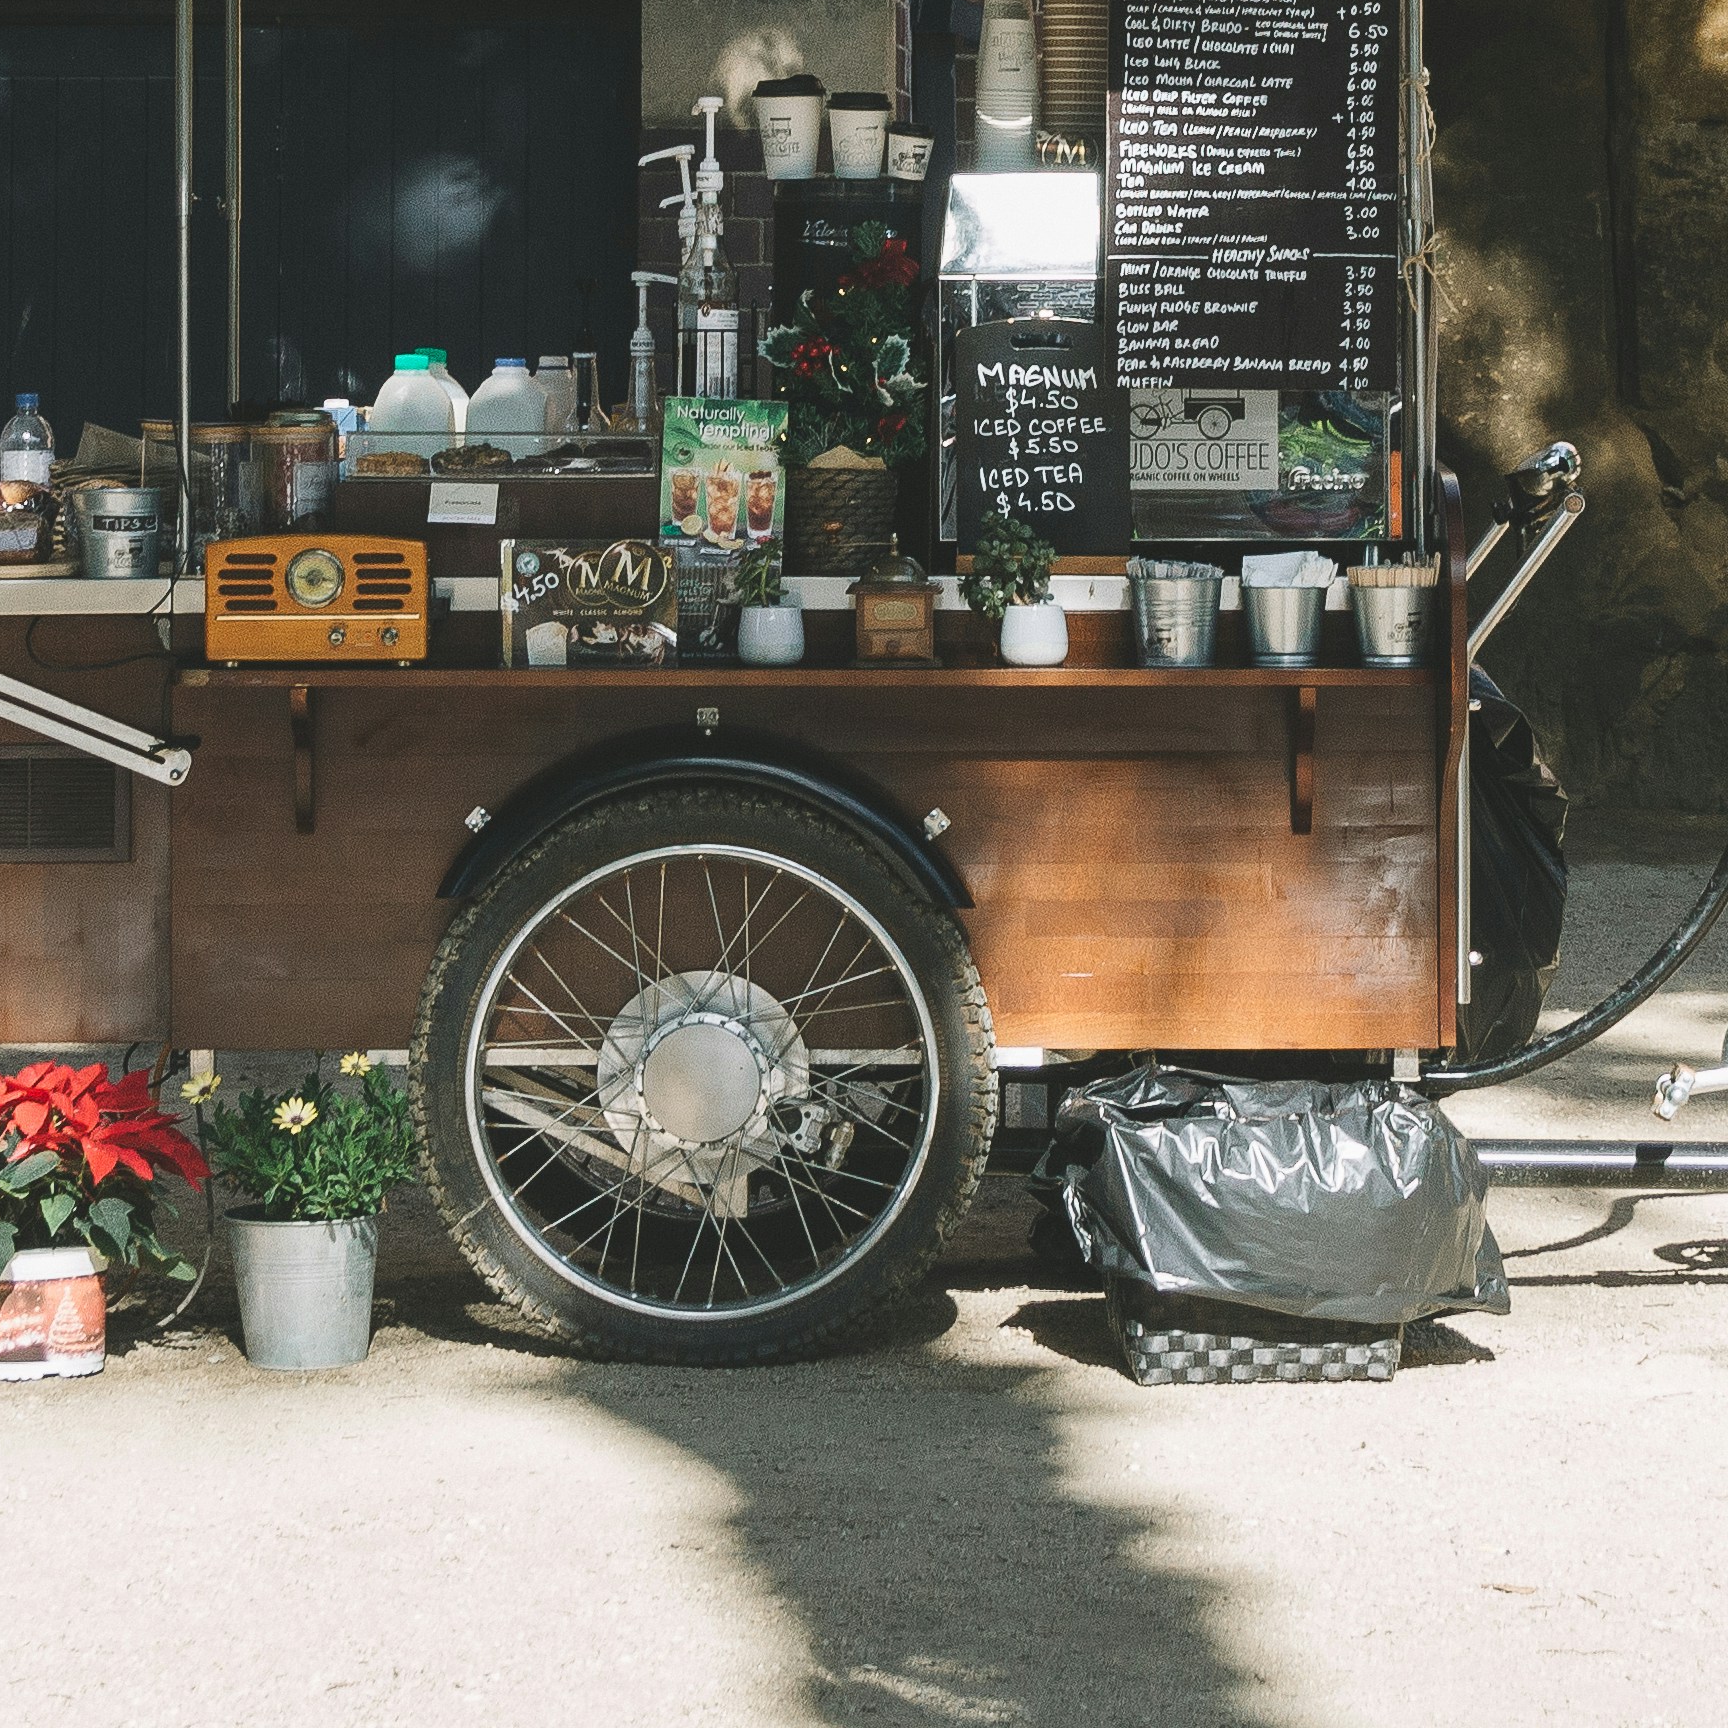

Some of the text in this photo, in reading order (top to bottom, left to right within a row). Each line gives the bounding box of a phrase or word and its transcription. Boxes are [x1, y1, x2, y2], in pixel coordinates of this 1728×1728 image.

[1350, 2, 1381, 16] 0.50
[1124, 15, 1150, 30] COOL
[1163, 17, 1196, 34] DIRTY
[1348, 22, 1388, 40] 6.50
[1126, 32, 1379, 58] ICED LATTE CHOCOLATE CHAI 5.50
[1124, 53, 1149, 68] ICED
[1184, 56, 1221, 71] BLACK
[1349, 60, 1378, 76] 5.00
[1124, 70, 1377, 92] ICED MOCHA CHARCOAL LATTE 6.00
[1222, 92, 1269, 106] COFFEE
[1346, 94, 1374, 111] 5.00
[1350, 111, 1374, 124] 1.00
[1119, 117, 1149, 136] ICED
[1152, 119, 1178, 137] TEA
[1346, 125, 1376, 141] 4.50
[1119, 140, 1198, 159] FIREWORKS
[1347, 143, 1374, 159] 6.50
[1120, 158, 1375, 177] MAGNUM ICE CREAM 4.50
[1116, 173, 1377, 191] TEA 4.00
[1115, 203, 1378, 221] BOTTLED WATER 3.00
[1114, 219, 1380, 240] CAN DRINKS 3.00
[1212, 244, 1311, 268] HEALTHY SNACKS
[1206, 266, 1259, 281] CHOCOLATE
[1264, 269, 1307, 282] TRUFFLE
[1345, 266, 1376, 280] 3.50
[1154, 283, 1186, 297] BALL
[1344, 282, 1374, 297] 3.50
[1118, 300, 1372, 318] FUNKY FUDGE BROWNIE 3.50
[1116, 318, 1371, 337] GLOW BAR 4.50
[1117, 335, 1371, 355] BANANA BREAD 4.00
[1117, 356, 1148, 373] PEAR
[1162, 355, 1231, 372] RASPBERRY
[1232, 358, 1283, 372] BANANA
[1288, 359, 1332, 374] BREAD
[1338, 356, 1369, 372] 4.50
[977, 361, 1098, 391] MAGNUM
[1116, 374, 1369, 391] MUFFIN 4.00
[1005, 386, 1079, 418] $4.50
[677, 404, 746, 424] Naturally
[698, 420, 775, 443] tempting!
[974, 417, 1107, 437] ICED COFFEE
[1194, 442, 1270, 471] COFFEE
[979, 462, 1083, 492] ICED TEA
[1162, 472, 1191, 482] COFFEE
[1193, 472, 1206, 482] ON
[1208, 472, 1240, 482] WHEELS
[102, 517, 141, 531] TIPS
[603, 579, 654, 603] MAGNUM
